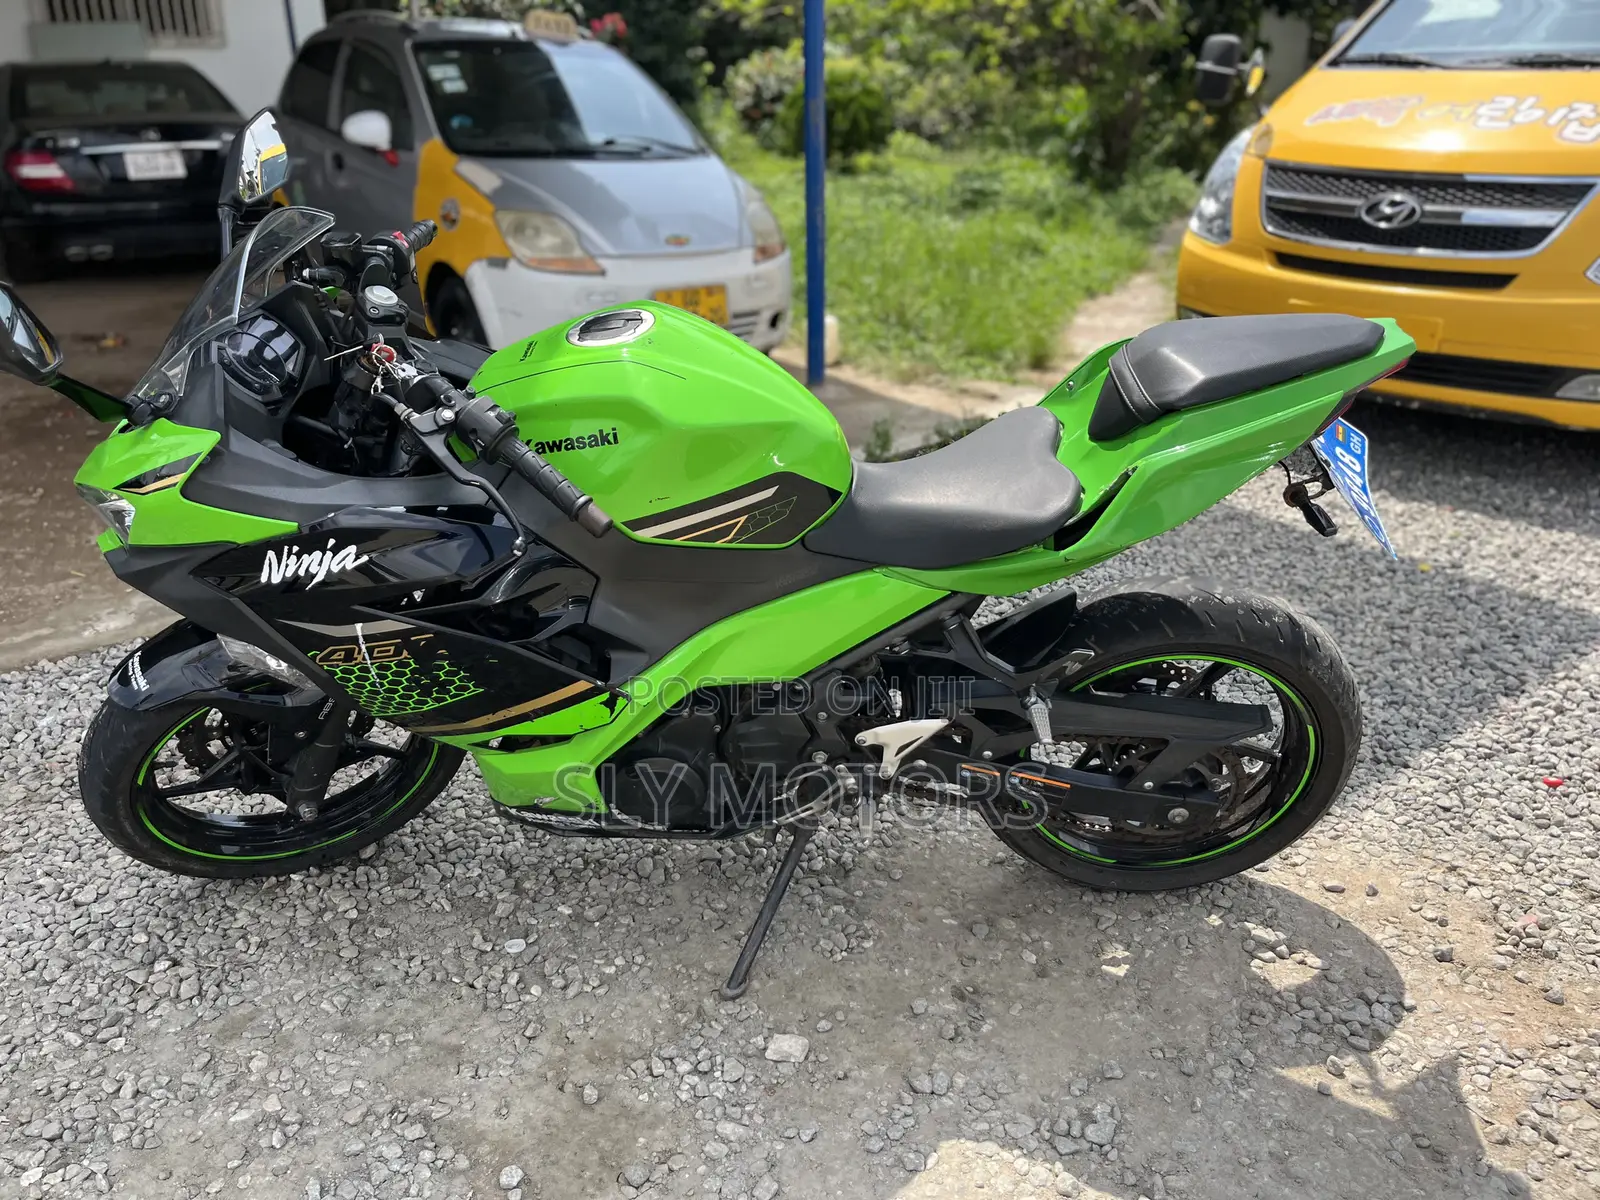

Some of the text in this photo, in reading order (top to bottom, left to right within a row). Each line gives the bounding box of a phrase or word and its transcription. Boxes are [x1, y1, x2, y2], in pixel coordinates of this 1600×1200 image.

[1350, 432, 1362, 455] GH
[260, 538, 370, 591] Ninja
[133, 650, 150, 691] Kawasaki
